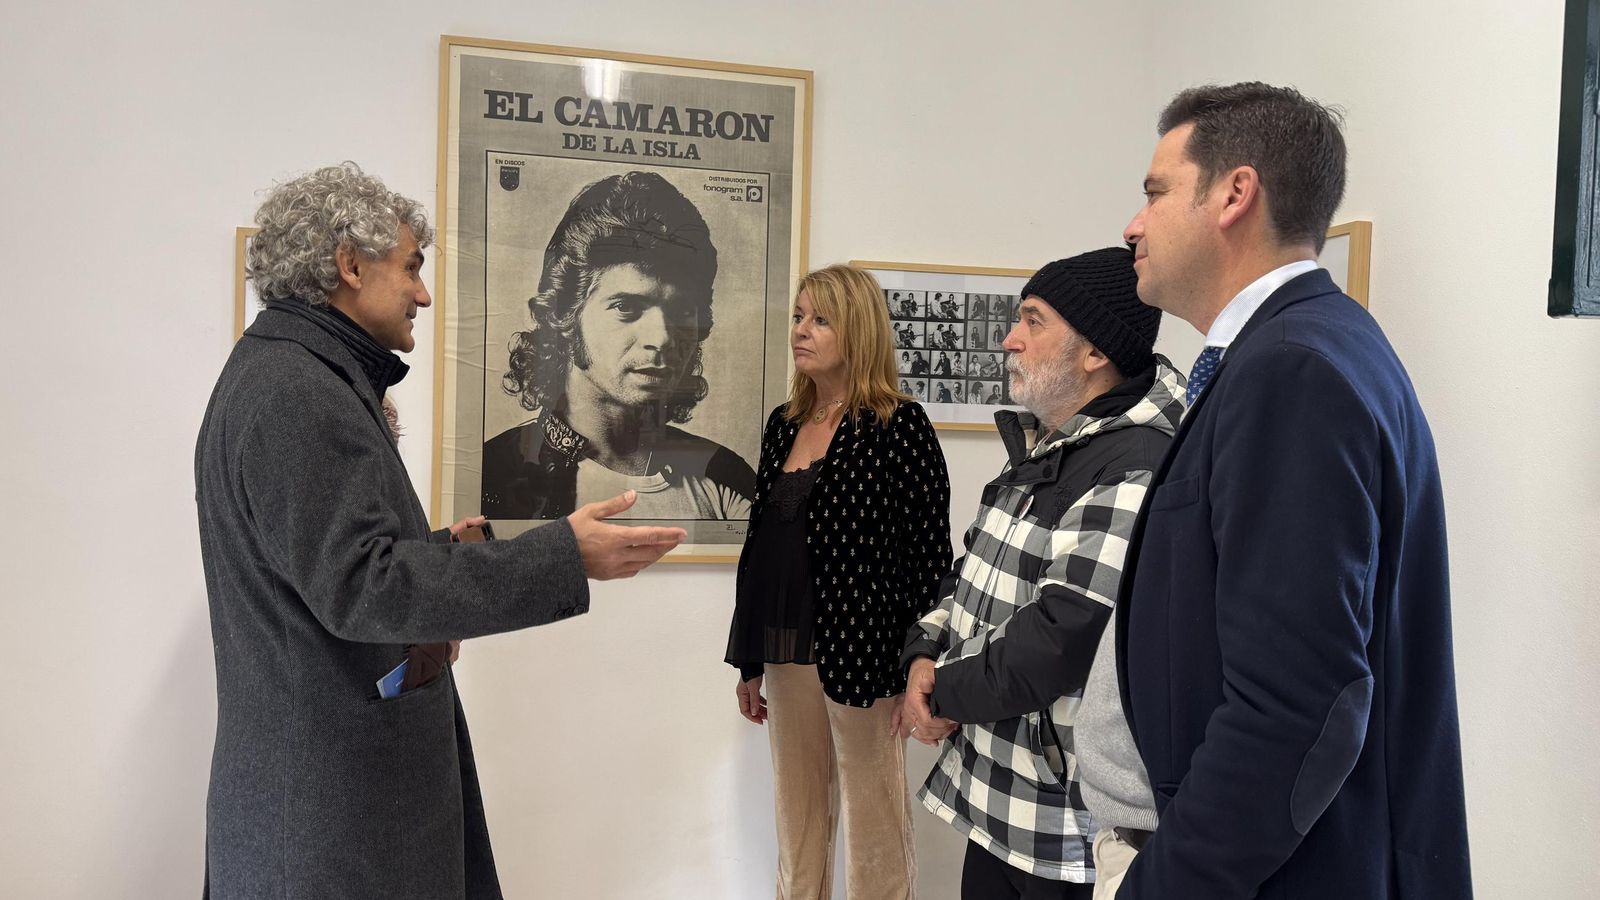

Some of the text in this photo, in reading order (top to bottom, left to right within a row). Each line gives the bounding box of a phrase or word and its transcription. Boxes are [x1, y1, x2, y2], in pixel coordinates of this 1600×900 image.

[483, 89, 774, 142] EL CAMARON
[562, 133, 701, 160] DE LA ISLA
[703, 184, 743, 193] fonogram
